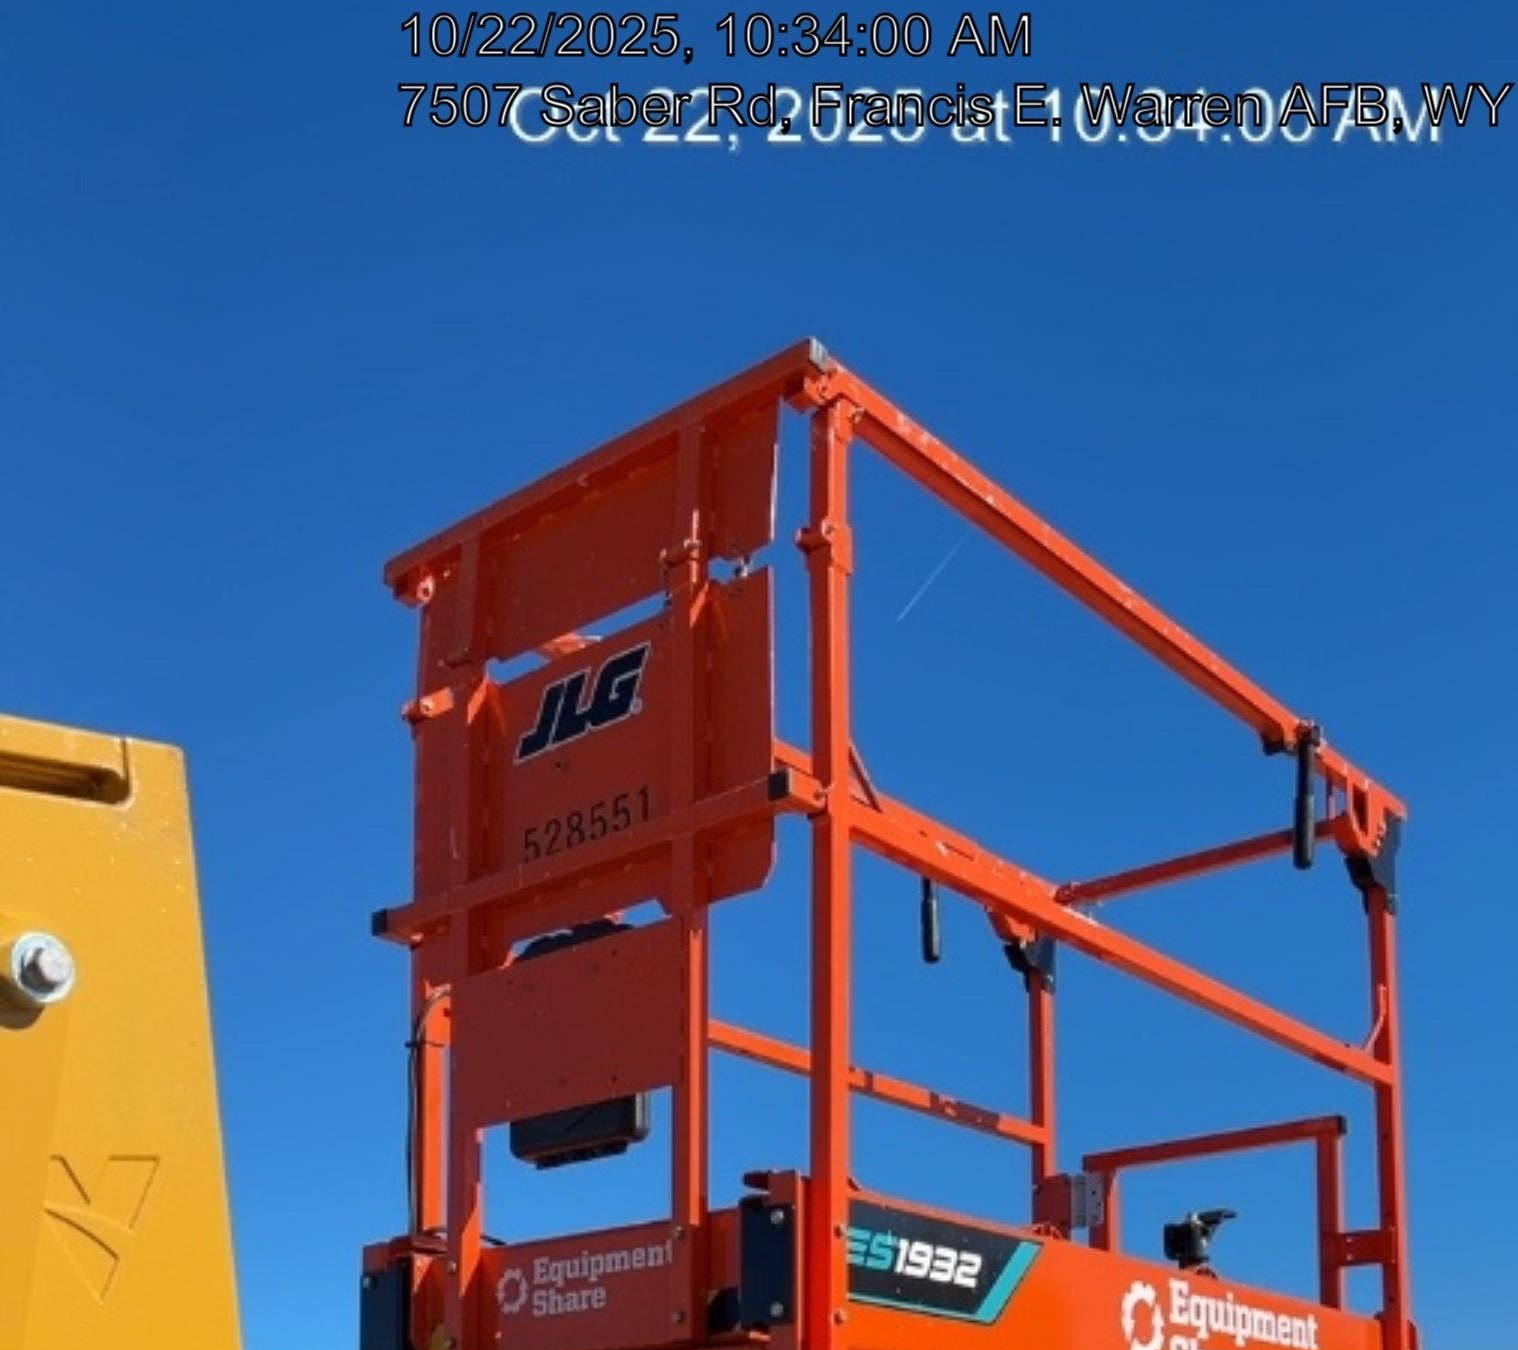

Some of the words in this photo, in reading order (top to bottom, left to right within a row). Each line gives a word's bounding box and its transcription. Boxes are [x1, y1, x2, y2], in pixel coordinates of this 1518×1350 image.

[513, 639, 652, 766] JLG
[522, 785, 651, 864] 528551
[532, 1286, 608, 1318] Share
[1168, 1278, 1319, 1350] Equipment
